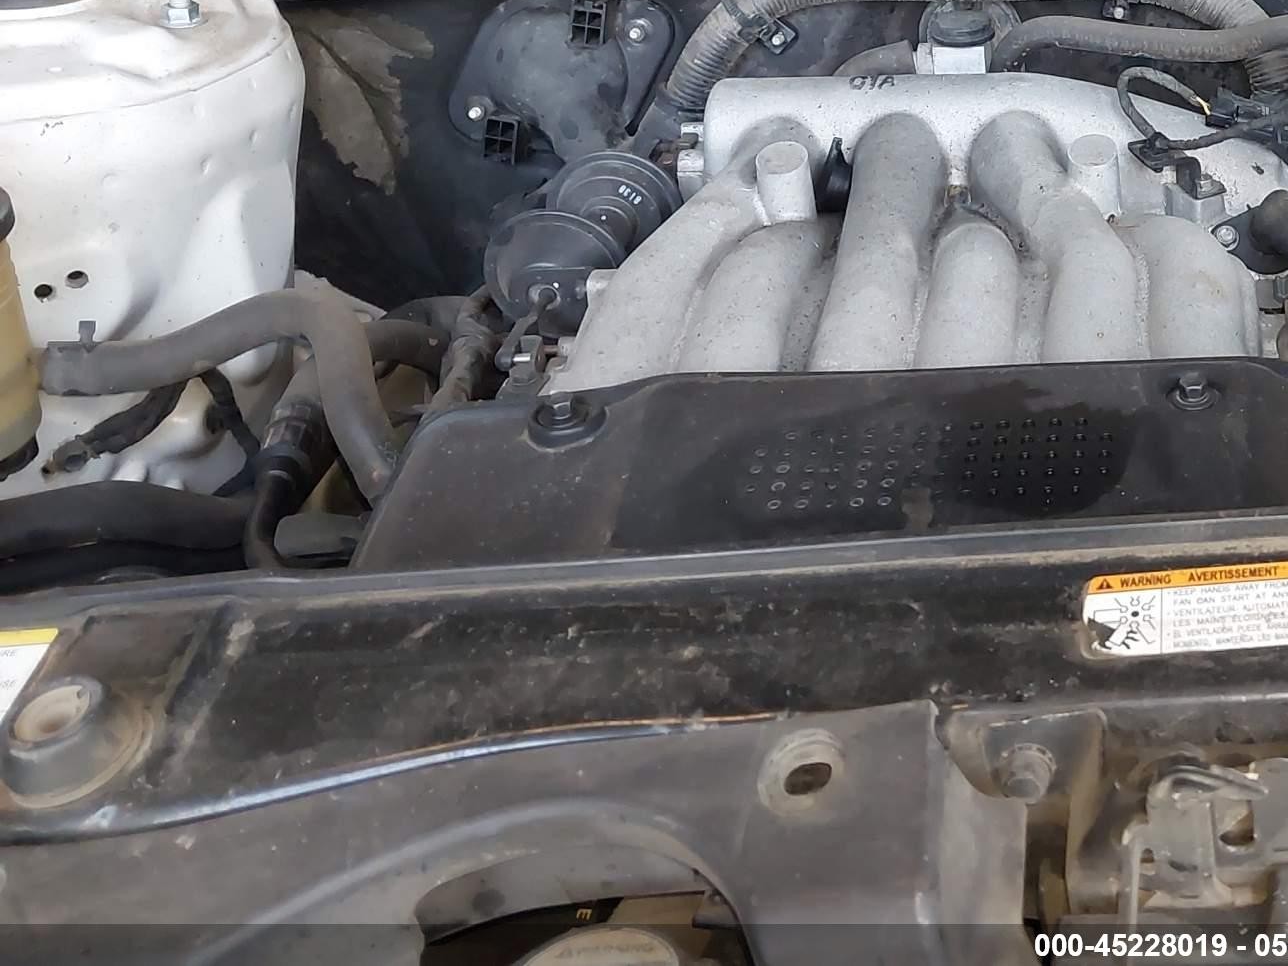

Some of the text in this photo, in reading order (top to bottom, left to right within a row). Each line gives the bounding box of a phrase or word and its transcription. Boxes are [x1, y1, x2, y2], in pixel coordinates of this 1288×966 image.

[1119, 574, 1171, 588] WARNING
[1188, 566, 1279, 582] AVERTISSEMENT
[1235, 583, 1259, 592] AWAY
[1264, 581, 1288, 589] FROM
[1221, 594, 1250, 603] START
